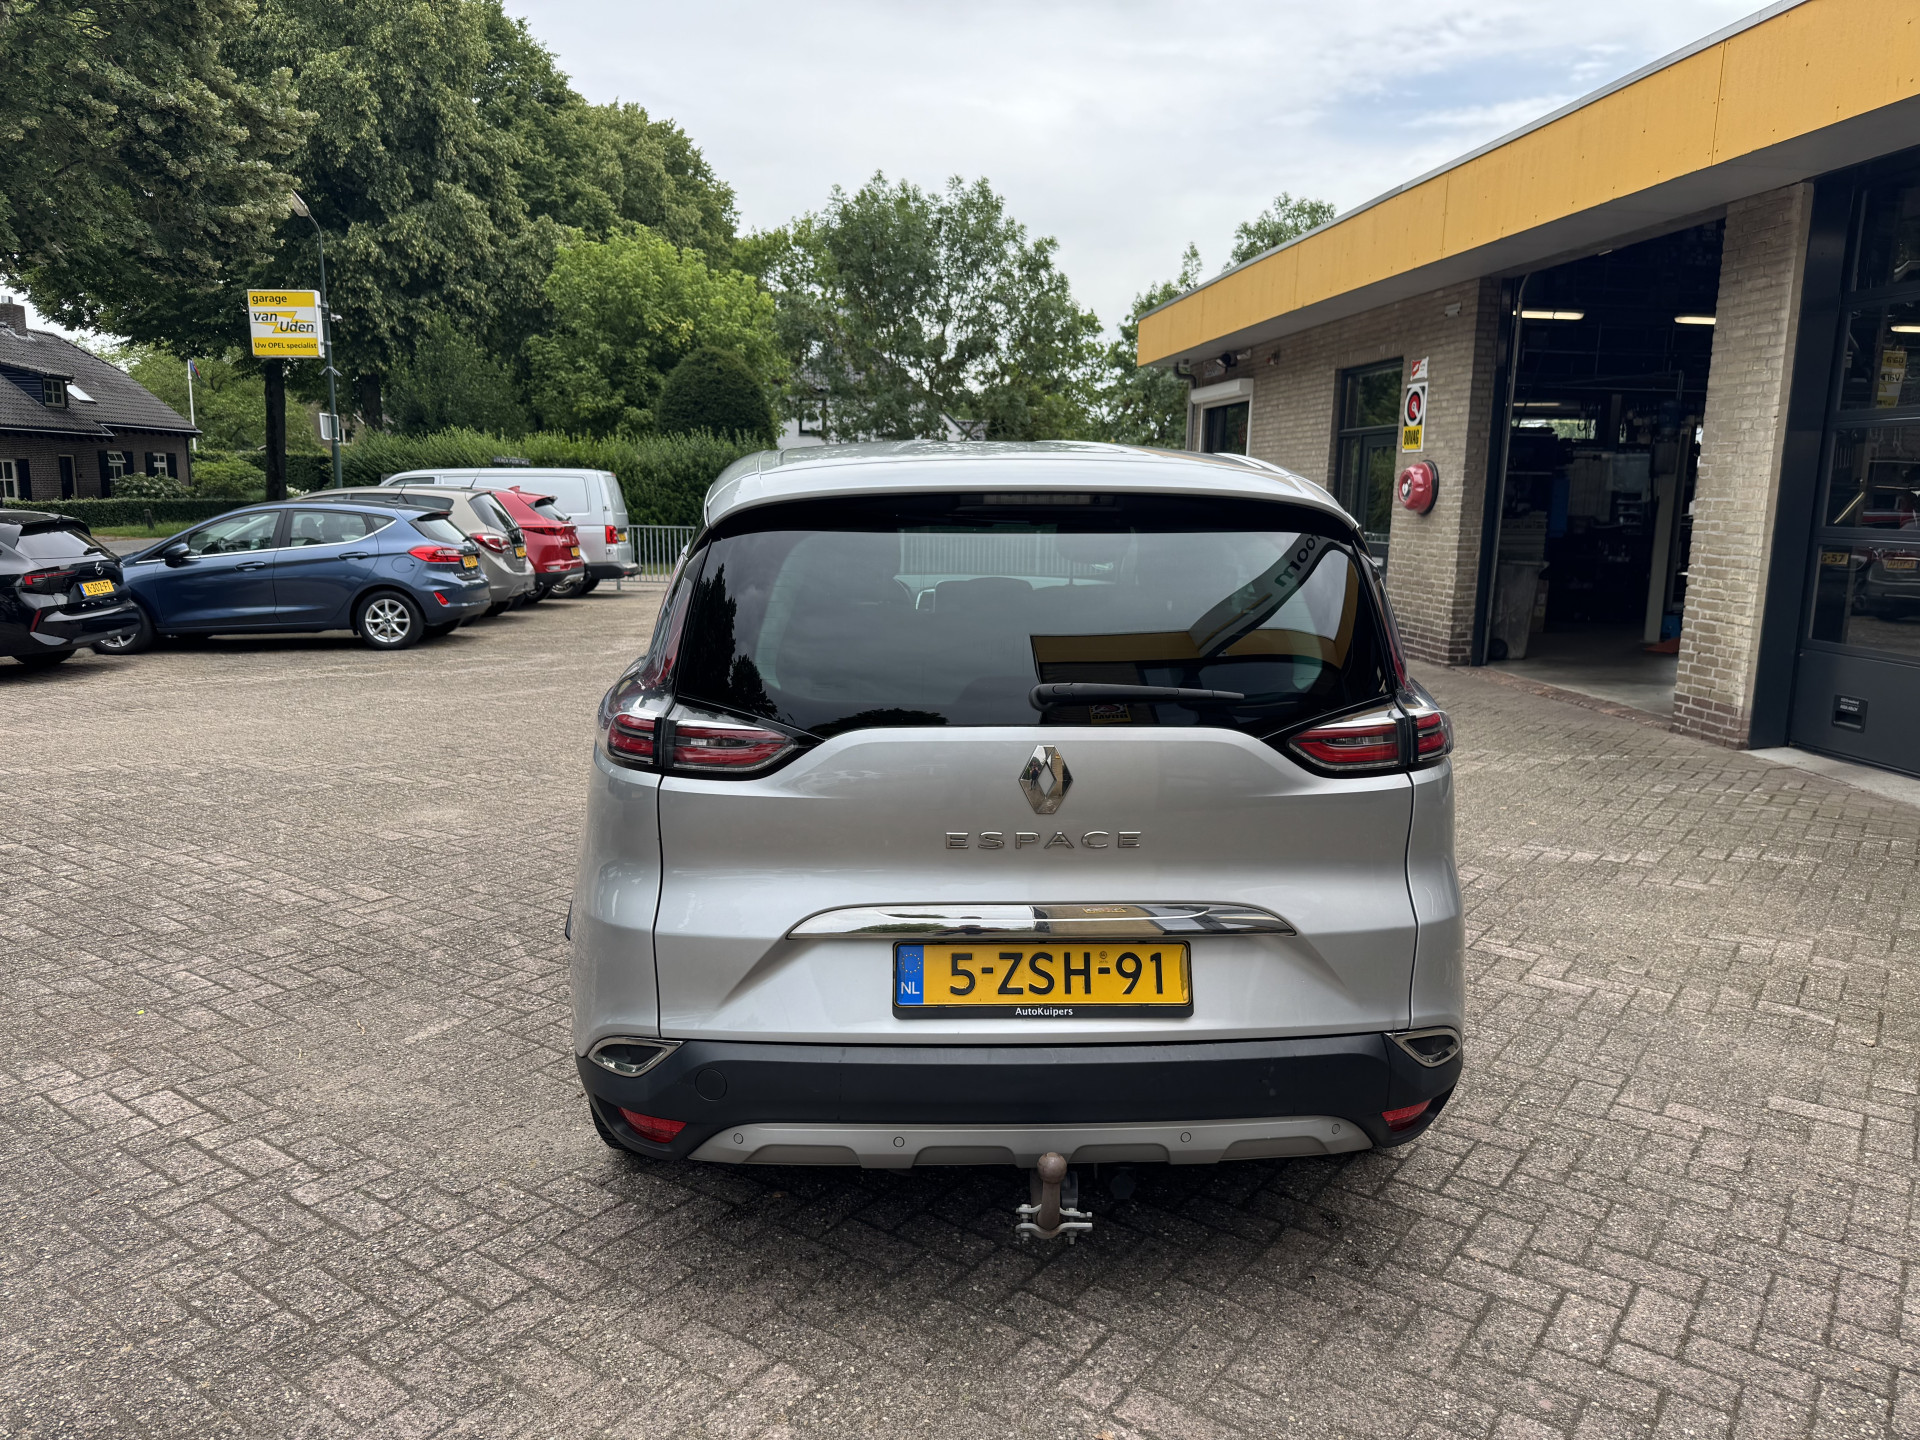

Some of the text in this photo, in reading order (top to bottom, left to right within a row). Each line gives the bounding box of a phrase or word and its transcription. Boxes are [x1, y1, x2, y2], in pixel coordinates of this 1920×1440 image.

[252, 295, 287, 304] garage
[253, 313, 314, 333] van Uden
[286, 342, 317, 350] specialist
[945, 830, 1142, 850] ESPACE
[900, 982, 920, 995] NL
[949, 952, 1164, 996] 5-ZSH-91
[1015, 1007, 1074, 1017] AutoKuipers
